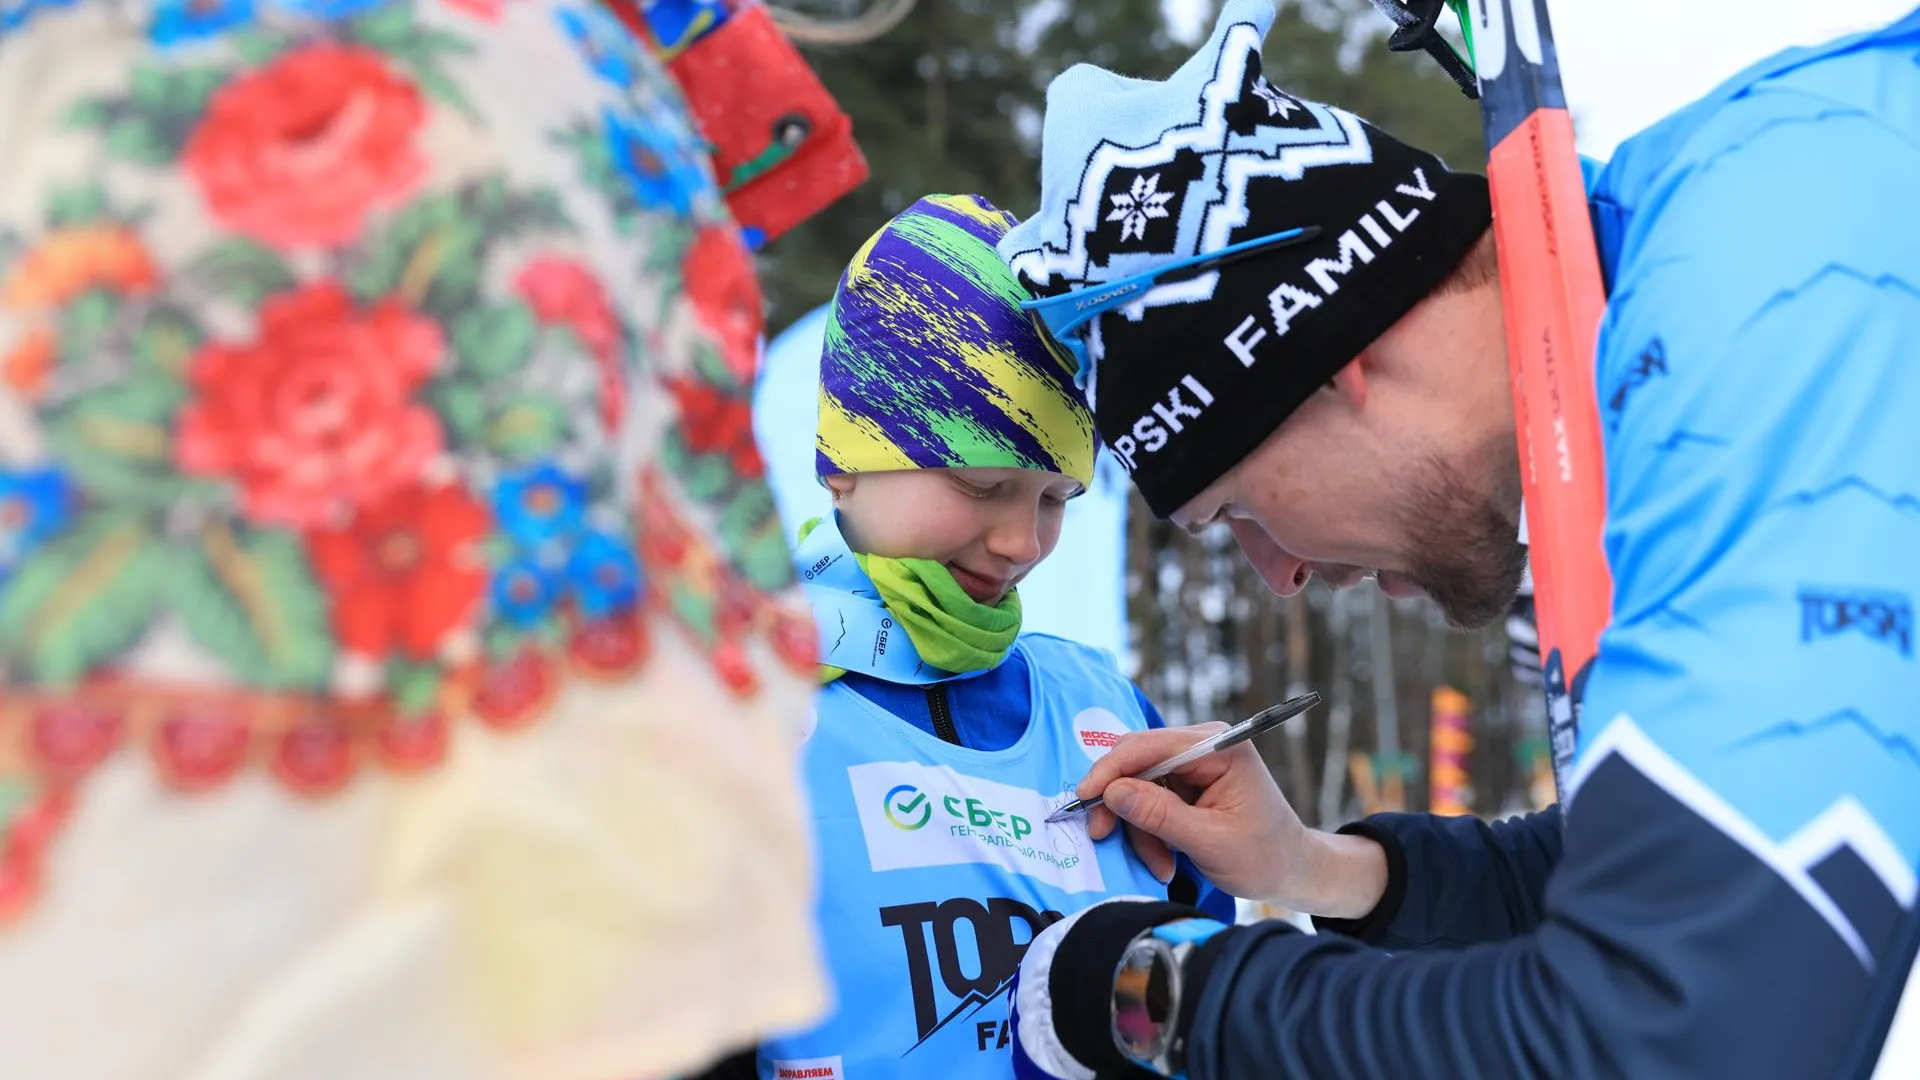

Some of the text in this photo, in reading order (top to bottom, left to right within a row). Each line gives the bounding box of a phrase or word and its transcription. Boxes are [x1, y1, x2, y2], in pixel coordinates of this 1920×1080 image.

[1109, 373, 1215, 476] PSKI
[1223, 167, 1437, 368] FAMILY
[812, 555, 830, 573] СБЕР
[878, 630, 888, 655] СБЕР
[943, 794, 1032, 841] СБЕР
[879, 897, 1066, 1041] TOP
